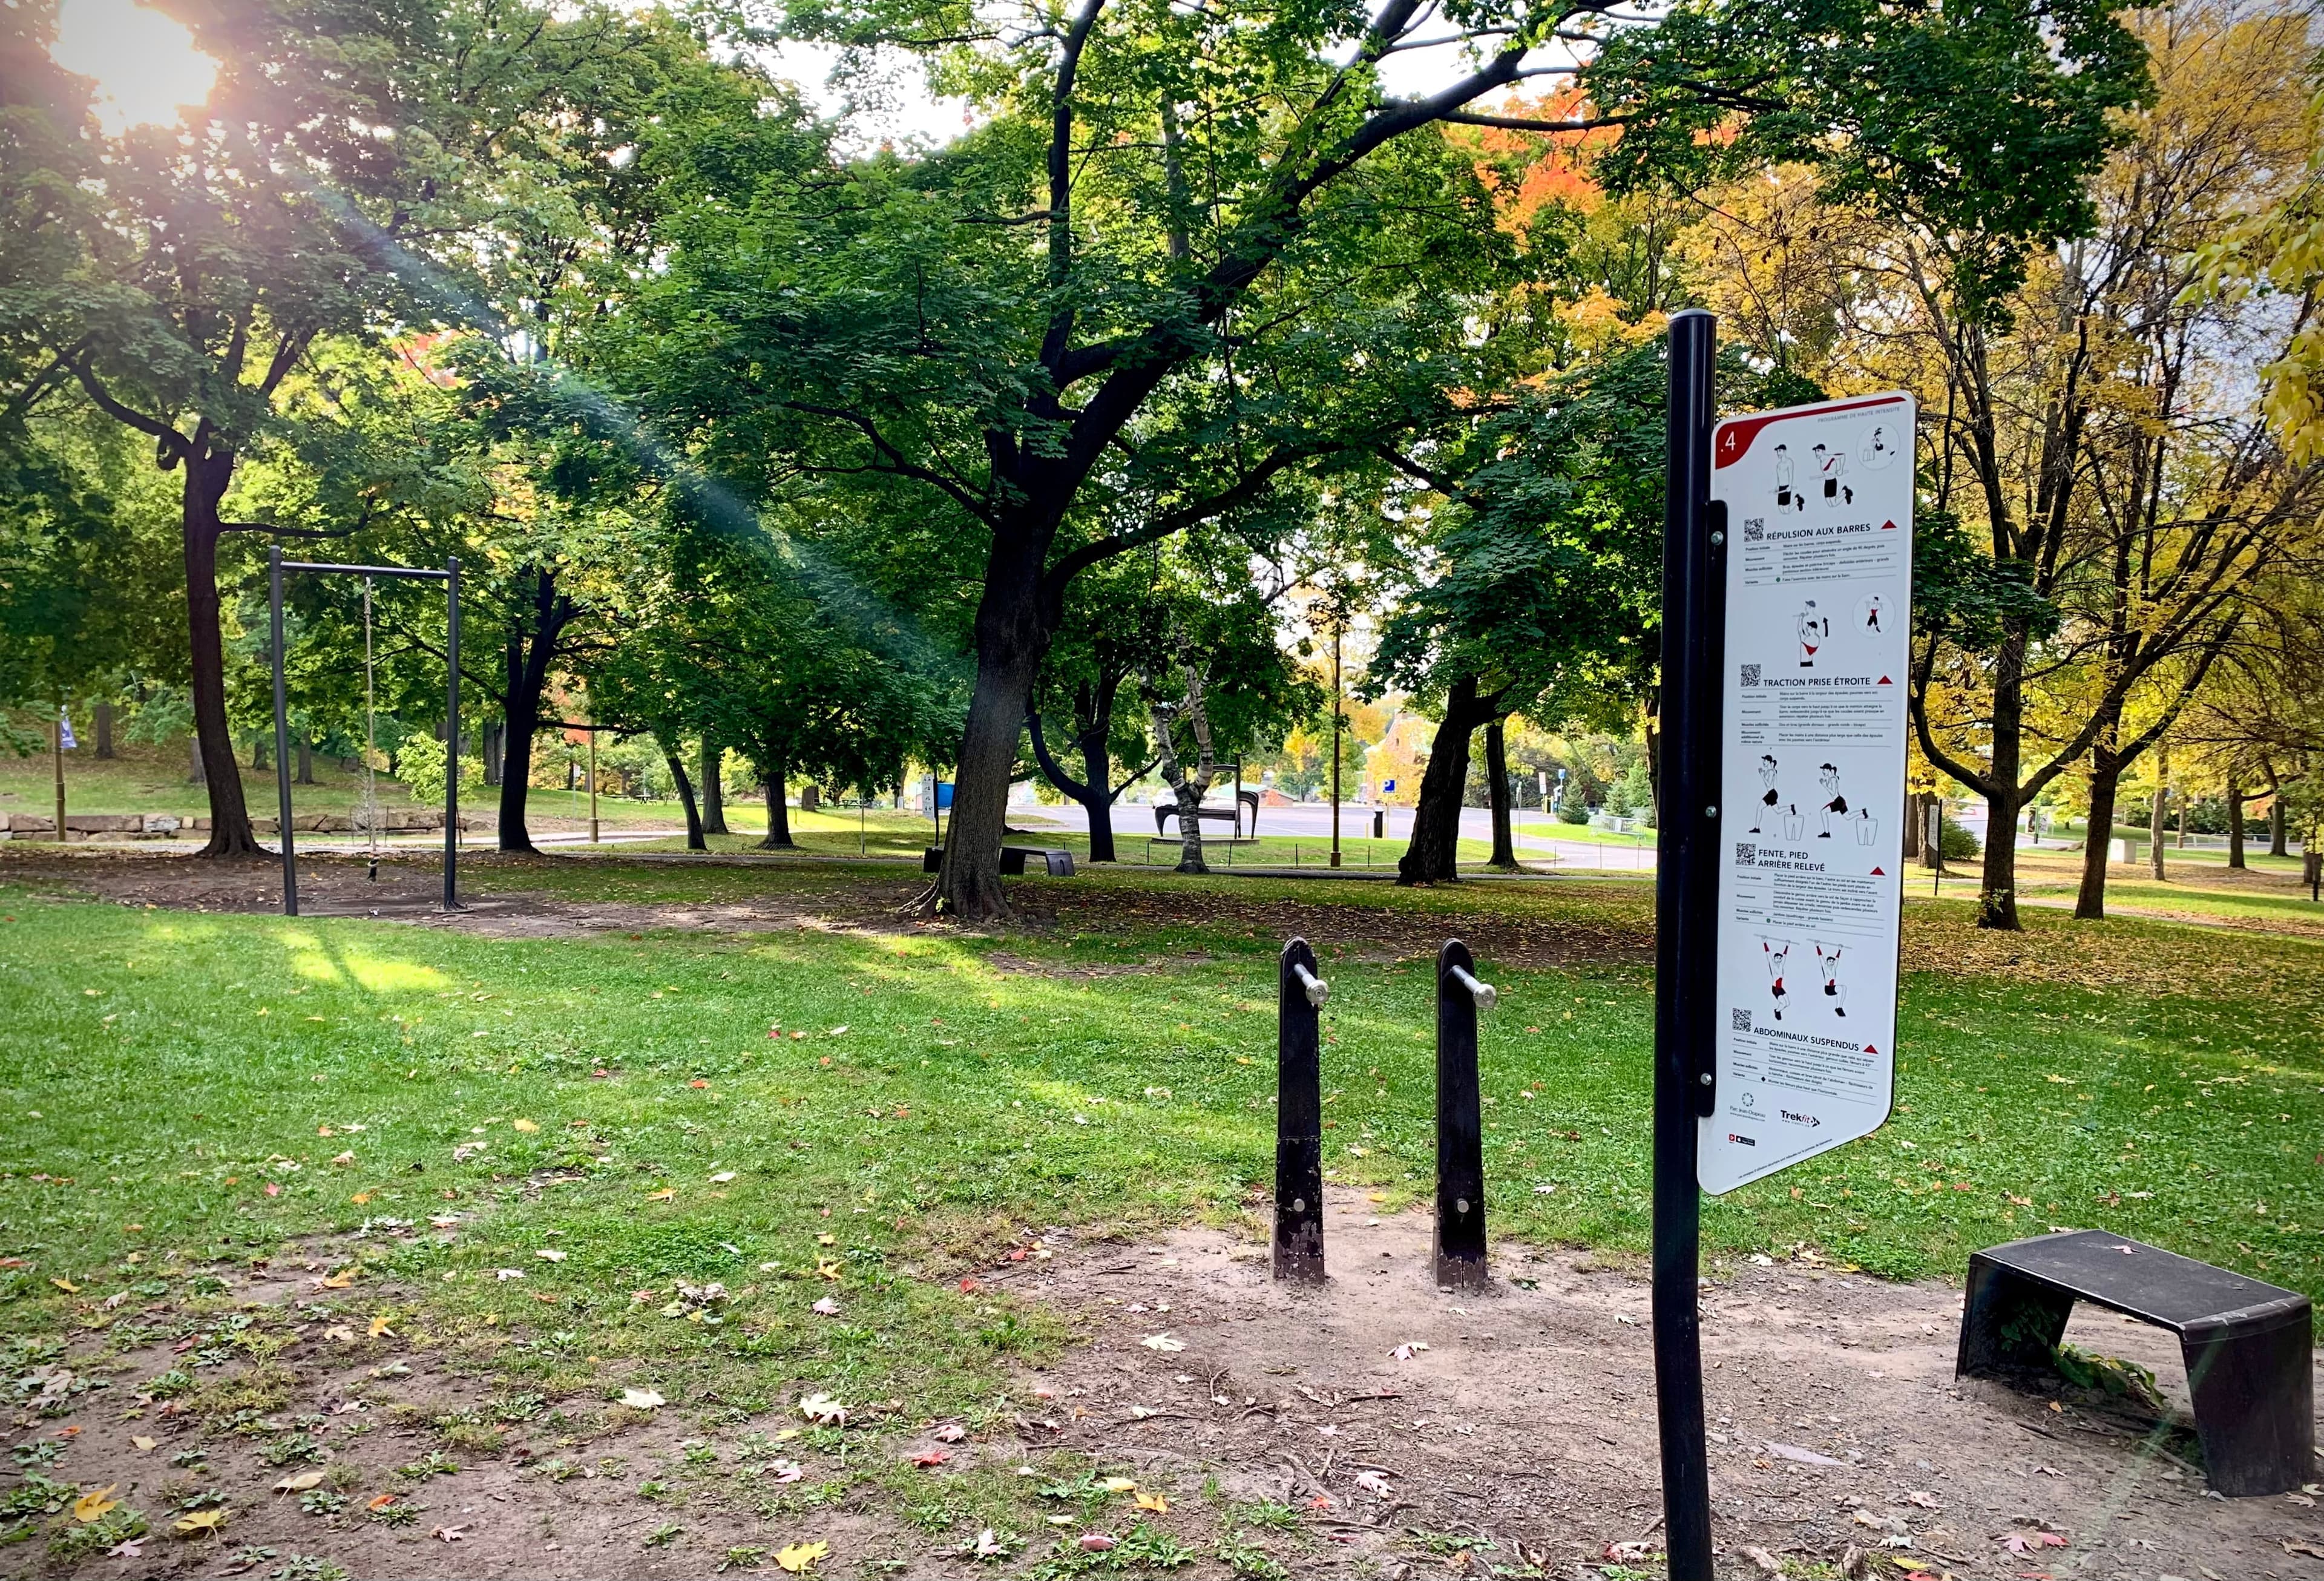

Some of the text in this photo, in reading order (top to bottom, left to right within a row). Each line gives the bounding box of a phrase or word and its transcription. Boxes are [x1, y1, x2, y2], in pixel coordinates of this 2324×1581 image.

[1767, 523, 1870, 540] RÉPULSION AUX BARRES
[1834, 676, 1870, 685] ÉTROITE
[1758, 849, 1787, 859] FENTE,
[1758, 860, 1825, 872] ARRIÈRE RELEVÉ
[1753, 1027, 1859, 1051] ABDOMINAUX SUSPENDUS
[1780, 1109, 1810, 1123] Trekfit
